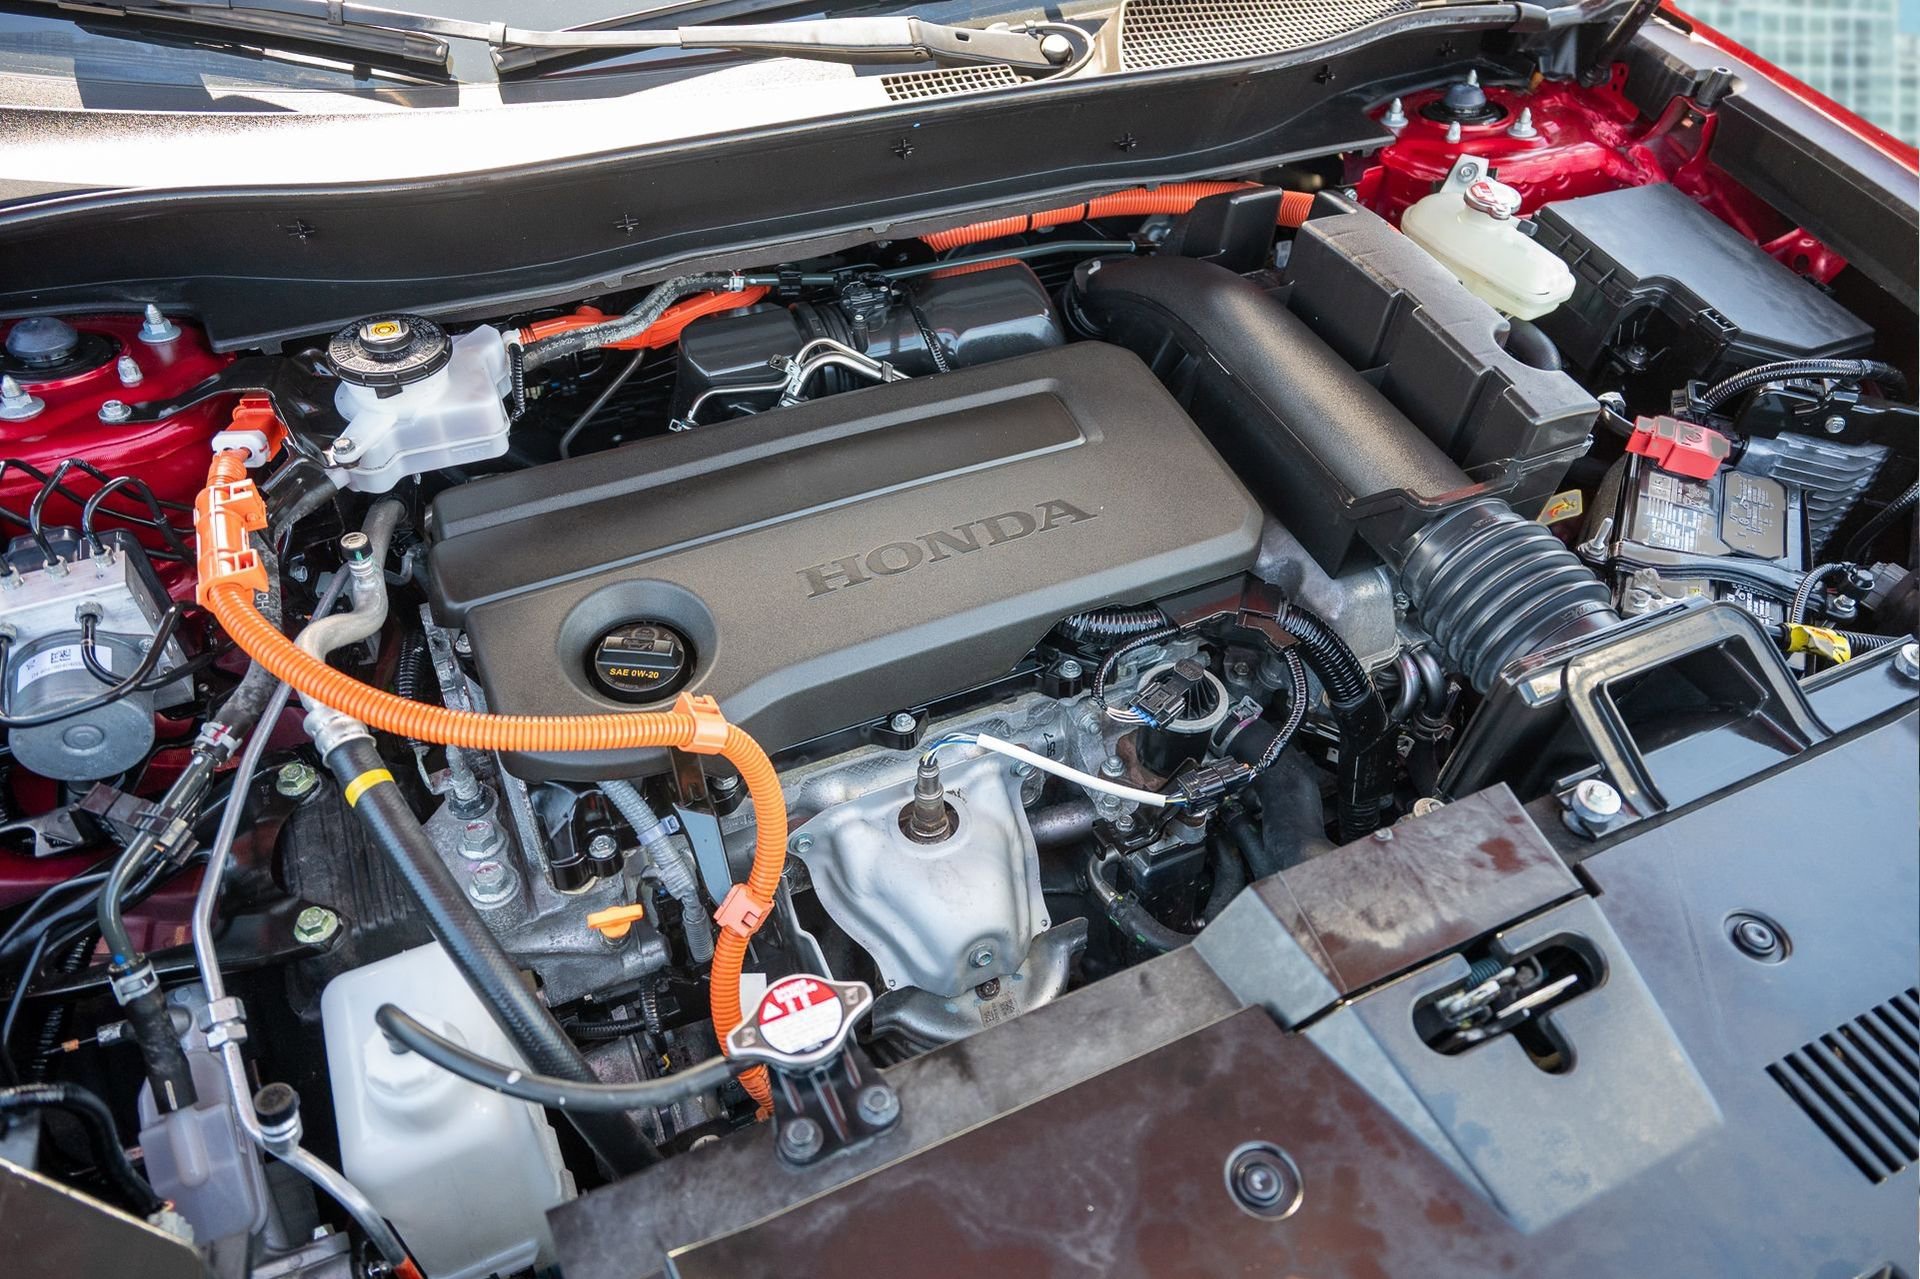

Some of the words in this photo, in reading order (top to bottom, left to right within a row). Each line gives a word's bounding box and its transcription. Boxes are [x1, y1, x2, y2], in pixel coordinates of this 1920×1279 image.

[796, 498, 1098, 599] HONDA
[609, 668, 630, 677] SAE
[631, 670, 660, 679] 0W-20
